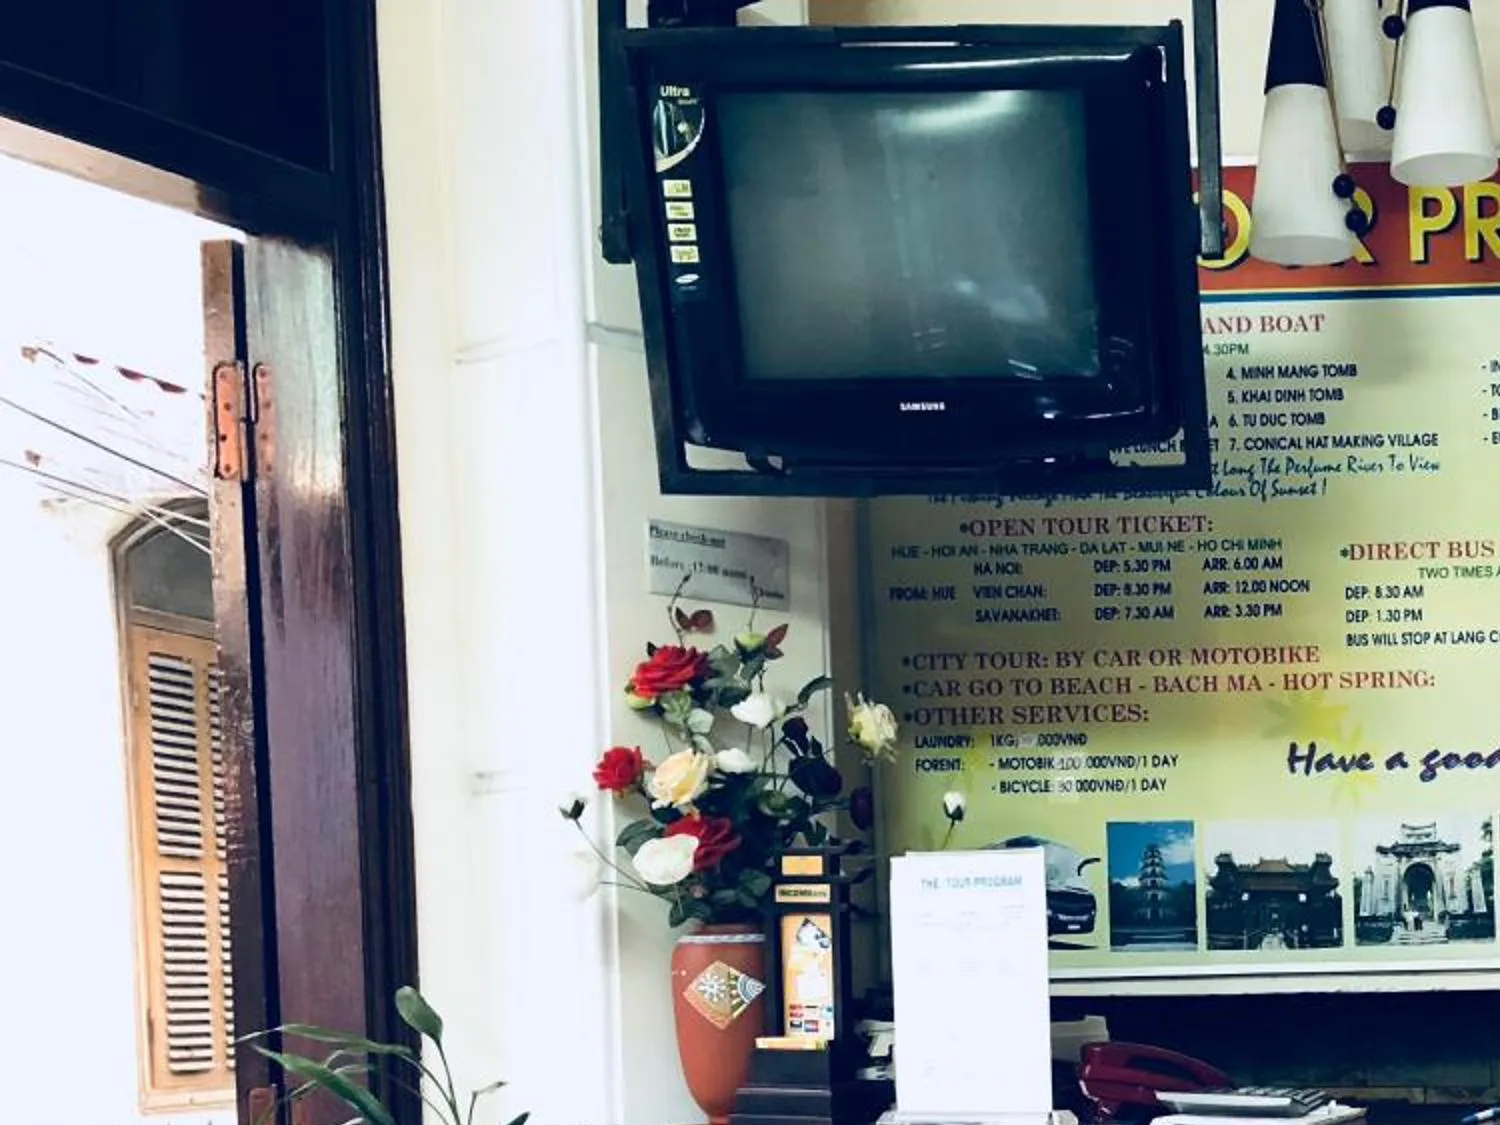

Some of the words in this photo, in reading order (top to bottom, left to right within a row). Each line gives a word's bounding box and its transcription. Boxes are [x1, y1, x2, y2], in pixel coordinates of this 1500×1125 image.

[660, 85, 690, 97] Ultra
[1203, 315, 1251, 334] AND
[1260, 313, 1326, 333] BOAT
[1241, 366, 1274, 380] MINH
[1278, 364, 1319, 379] MANG
[1322, 363, 1357, 377] TOMB
[1241, 390, 1271, 403] KHAI
[1275, 389, 1306, 402] DINH
[1309, 388, 1344, 401] TOMB
[900, 401, 945, 411] SAMSUNG
[1243, 414, 1257, 427] TU
[1260, 413, 1286, 426] DUC
[1290, 412, 1325, 425] TOMB
[1244, 437, 1303, 451] CONICAL
[1305, 436, 1329, 449] HAT
[1332, 435, 1384, 448] MAKING
[1387, 433, 1438, 447] VILLAGE
[1285, 456, 1341, 478] Perfume
[1388, 454, 1404, 471] To
[1409, 453, 1441, 472] View
[1272, 479, 1316, 498] Sunset
[970, 518, 1036, 537] OPEN
[1041, 517, 1109, 536] TOUR
[1116, 515, 1214, 534] TICKET:
[891, 546, 919, 559] HUE
[932, 544, 955, 558] HOI
[958, 543, 979, 557] AN
[988, 543, 1017, 557] NHA
[1019, 542, 1069, 556] TRANG
[1102, 541, 1126, 554] LAT
[1166, 539, 1185, 553] NE
[1197, 538, 1218, 552] HO
[1220, 538, 1245, 551] CHI
[1247, 537, 1282, 550] MINH
[1350, 541, 1441, 561] DIRECT
[1448, 540, 1495, 559] BUS
[974, 562, 993, 576] HA
[1123, 559, 1148, 573] 5.30
[1233, 557, 1259, 571] 6.00
[1419, 567, 1449, 579] TWO
[1454, 566, 1494, 578] TIMES
[973, 585, 1003, 600] VIEN
[1004, 584, 1048, 599] CHAN:
[1235, 580, 1267, 594] 12.00
[1268, 579, 1311, 593] NOON
[1125, 606, 1148, 620] 7.30
[1234, 604, 1260, 618] 3.30
[1376, 609, 1401, 622] 1.30
[1346, 634, 1369, 647] BUS
[1371, 633, 1398, 646] WILL
[1401, 632, 1431, 646] STOP
[1433, 631, 1449, 644] AT
[1451, 630, 1486, 644] LANG
[912, 653, 969, 672] CITY
[974, 652, 1050, 671] TOUR:
[1055, 651, 1086, 669] BY
[1093, 650, 1141, 668] CAR
[1149, 649, 1183, 667] OR
[1191, 645, 1320, 666] MOTOBIKE
[913, 680, 961, 698] CAR
[968, 679, 1004, 697] GO
[1010, 678, 1043, 696] TO
[1050, 676, 1132, 695] BEACH
[1153, 675, 1219, 694] BACH
[1227, 674, 1263, 693] MA
[1282, 672, 1333, 691] HOT
[1338, 670, 1436, 690] SPRING:
[914, 707, 1005, 726] OTHER
[1011, 704, 1149, 724] SERVICES:
[1151, 754, 1179, 768] DAY
[1287, 740, 1374, 776] Have
[1386, 751, 1408, 772] a
[1141, 778, 1167, 792] DAY
